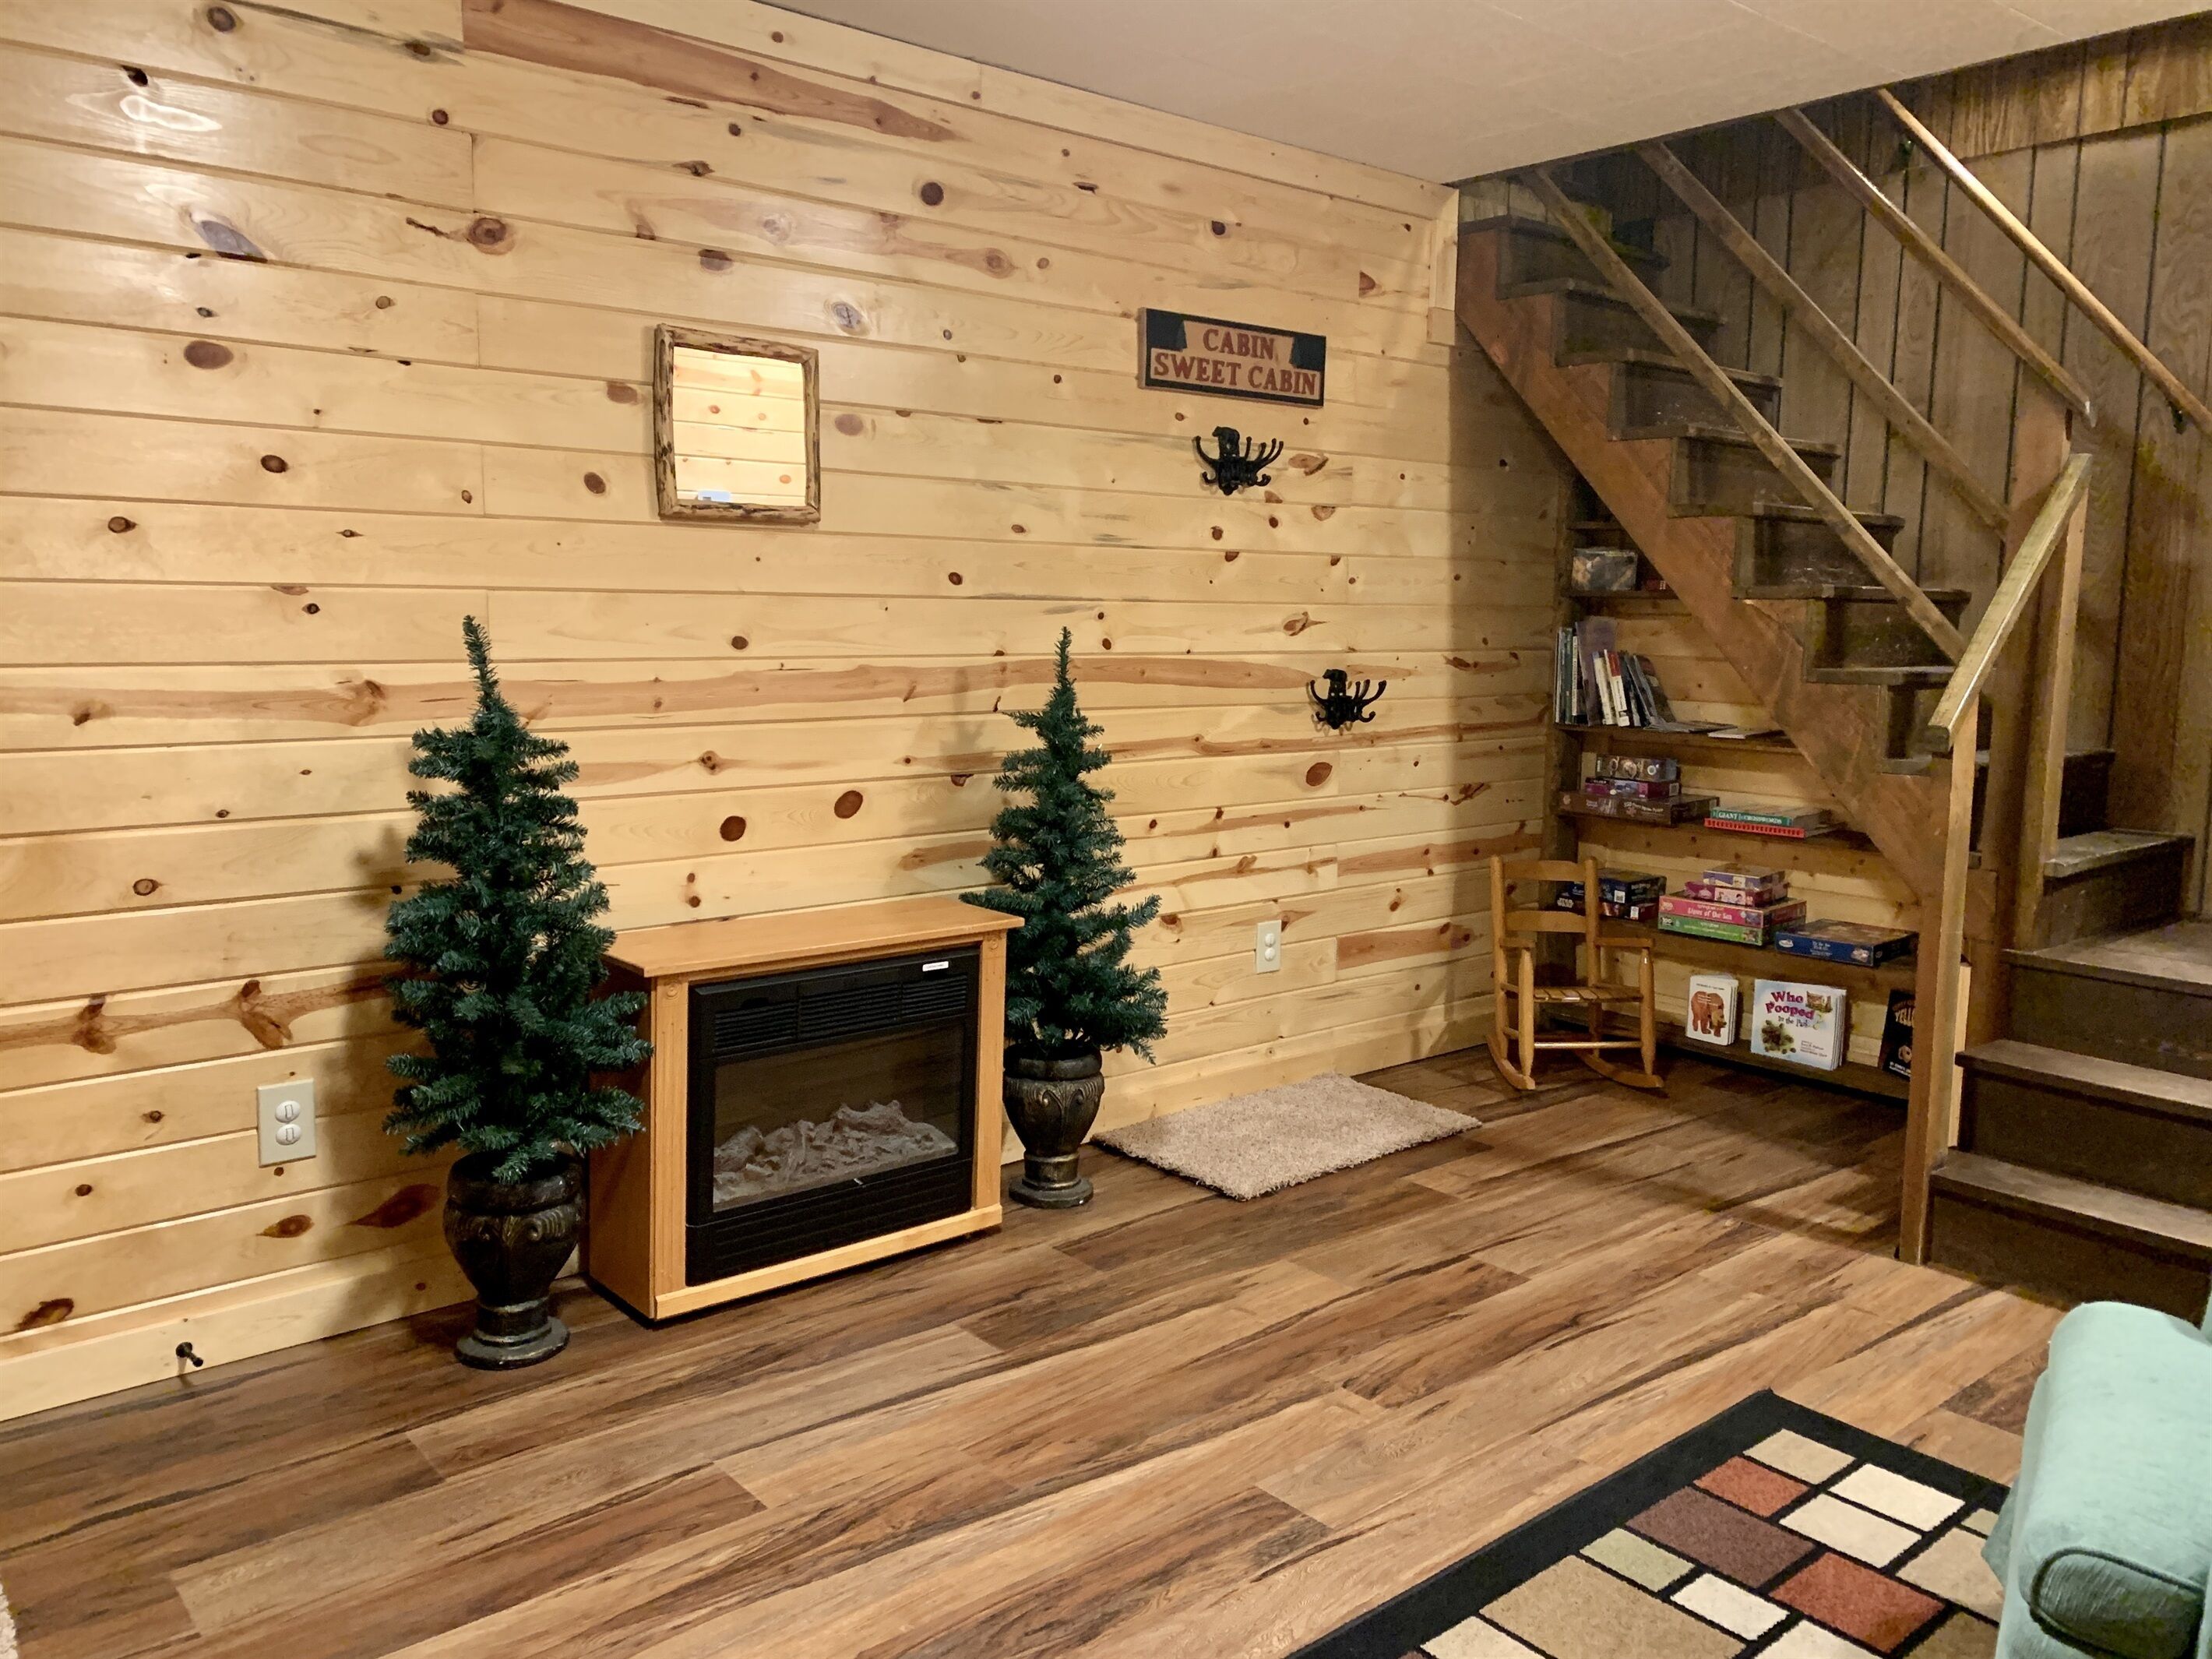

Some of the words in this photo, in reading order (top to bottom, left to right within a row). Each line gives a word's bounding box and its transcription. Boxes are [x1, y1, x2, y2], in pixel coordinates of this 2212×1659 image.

[1203, 328, 1275, 361] CABIN
[1153, 352, 1242, 386] SWEET
[1247, 365, 1317, 396] CABIN
[1718, 812, 1738, 820] GIANT
[1770, 990, 1804, 1004] Who
[1765, 1001, 1816, 1020] Pooped
